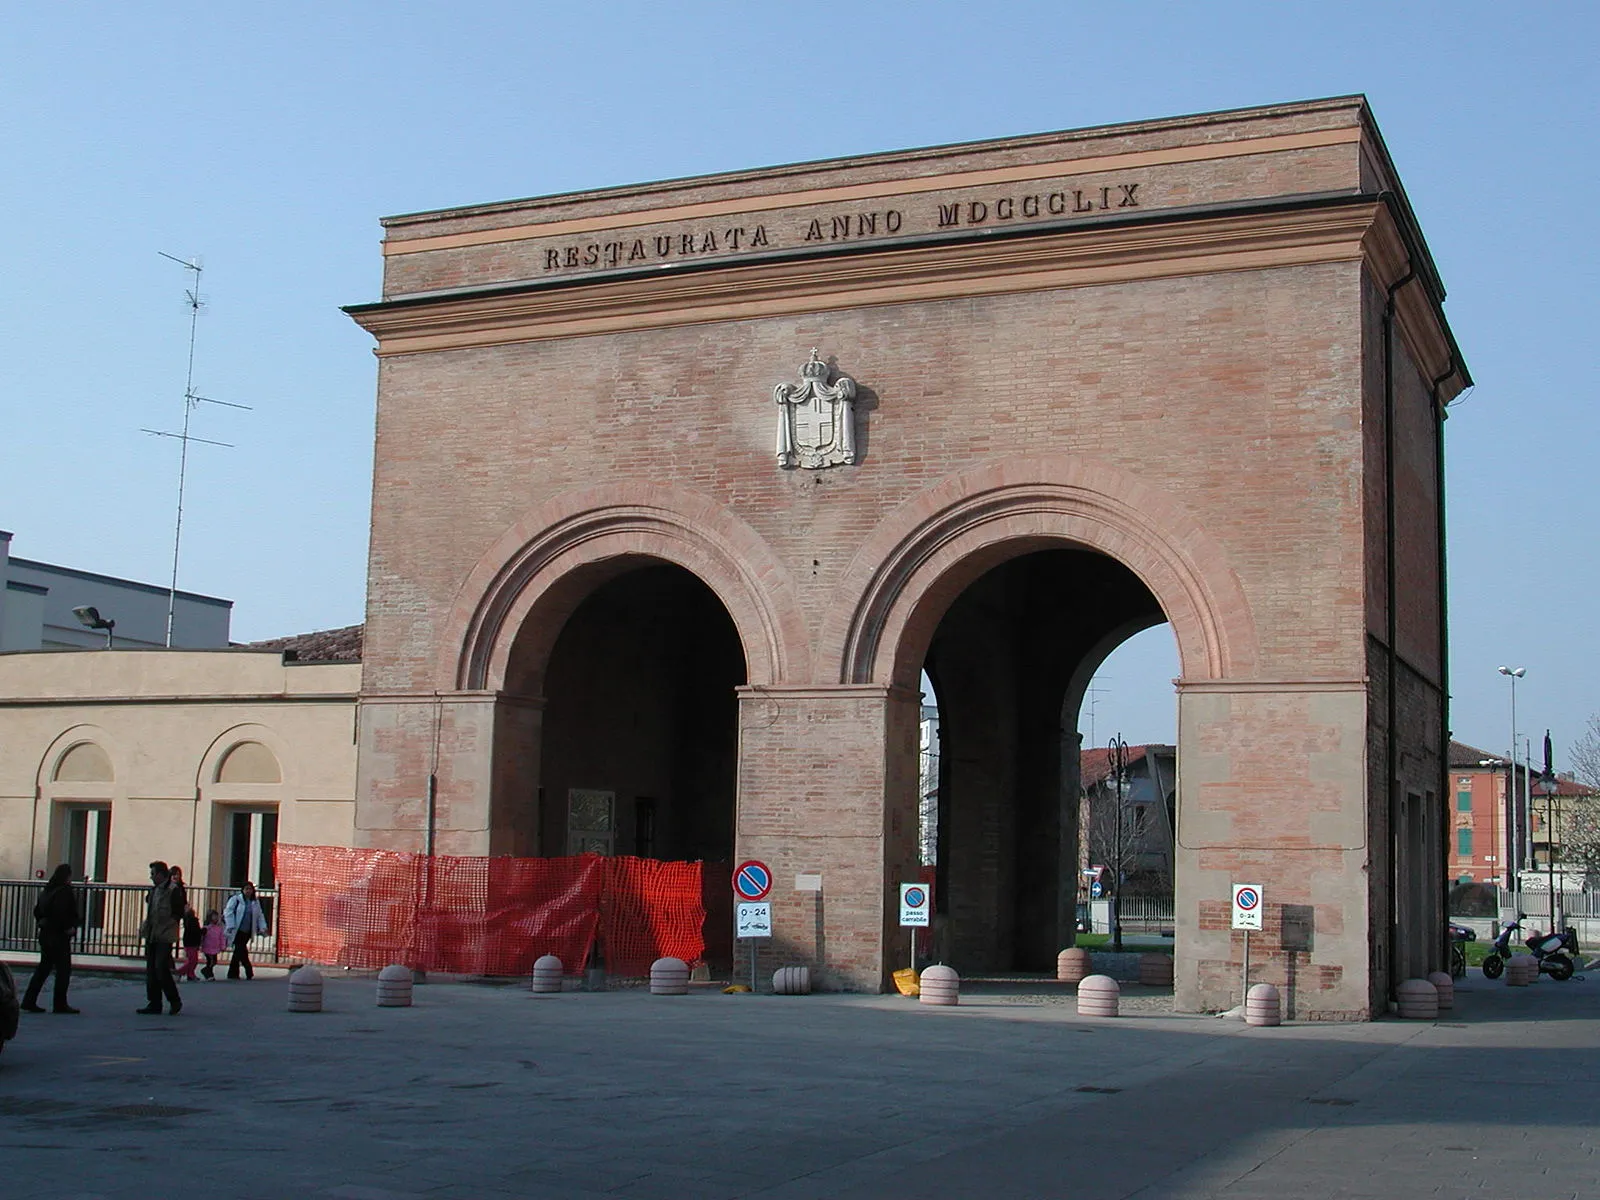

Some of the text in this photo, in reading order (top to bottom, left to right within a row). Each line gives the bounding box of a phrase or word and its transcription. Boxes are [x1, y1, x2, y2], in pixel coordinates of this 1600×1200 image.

[543, 183, 1140, 270] RESTAURATA ANNO MDCCCLIX
